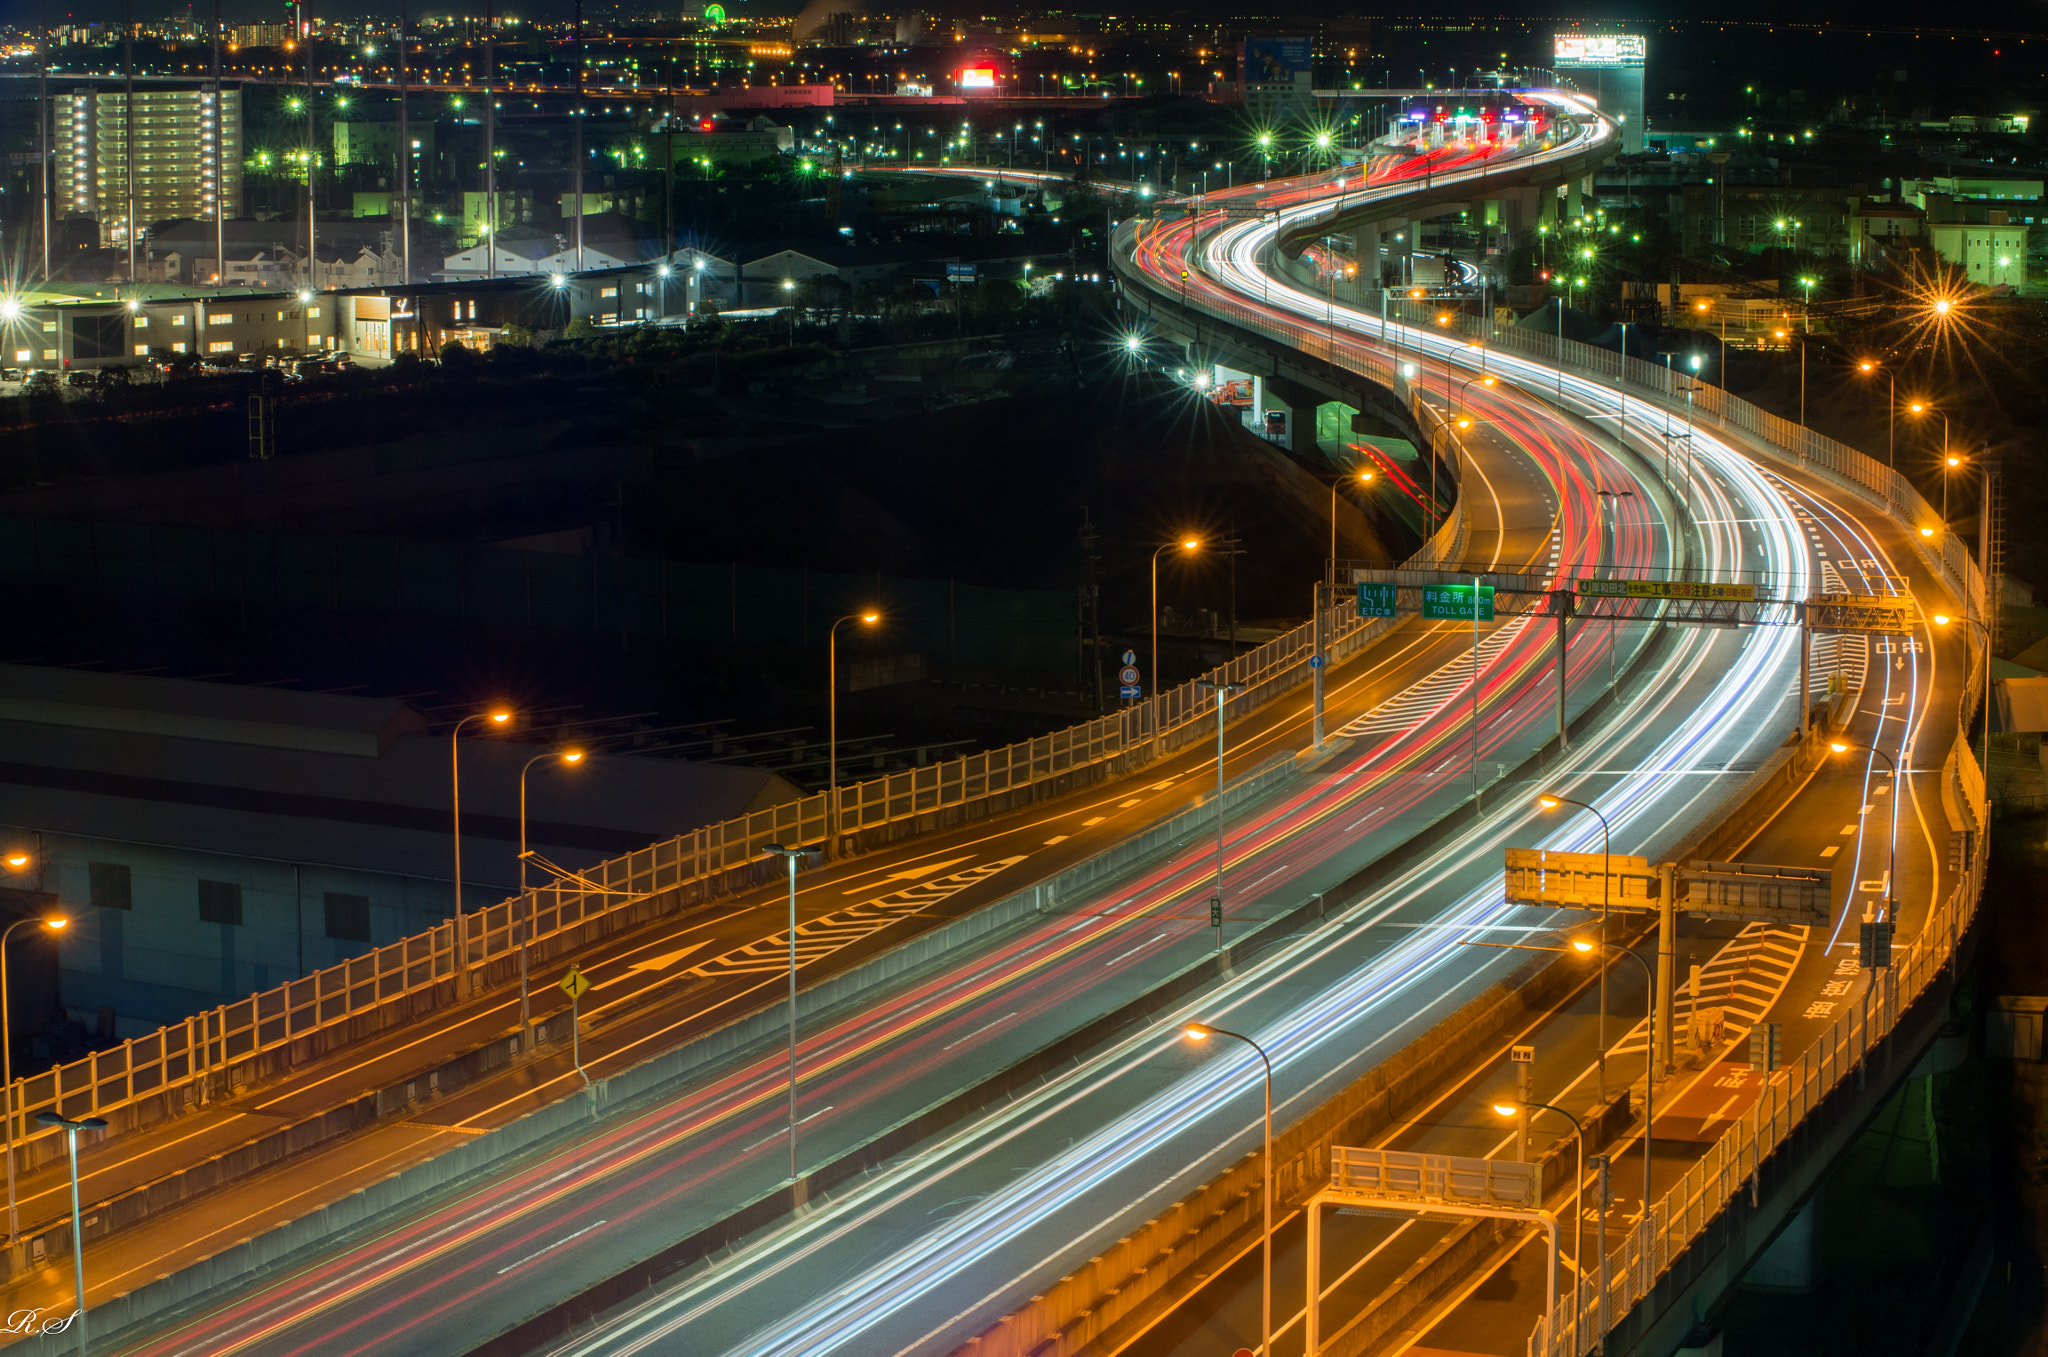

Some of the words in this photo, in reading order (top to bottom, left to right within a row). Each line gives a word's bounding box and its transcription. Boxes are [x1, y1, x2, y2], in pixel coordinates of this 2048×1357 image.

[1426, 591, 1464, 604] 料金所
[1431, 605, 1456, 615] TOLL
[1124, 671, 1135, 680] 40
